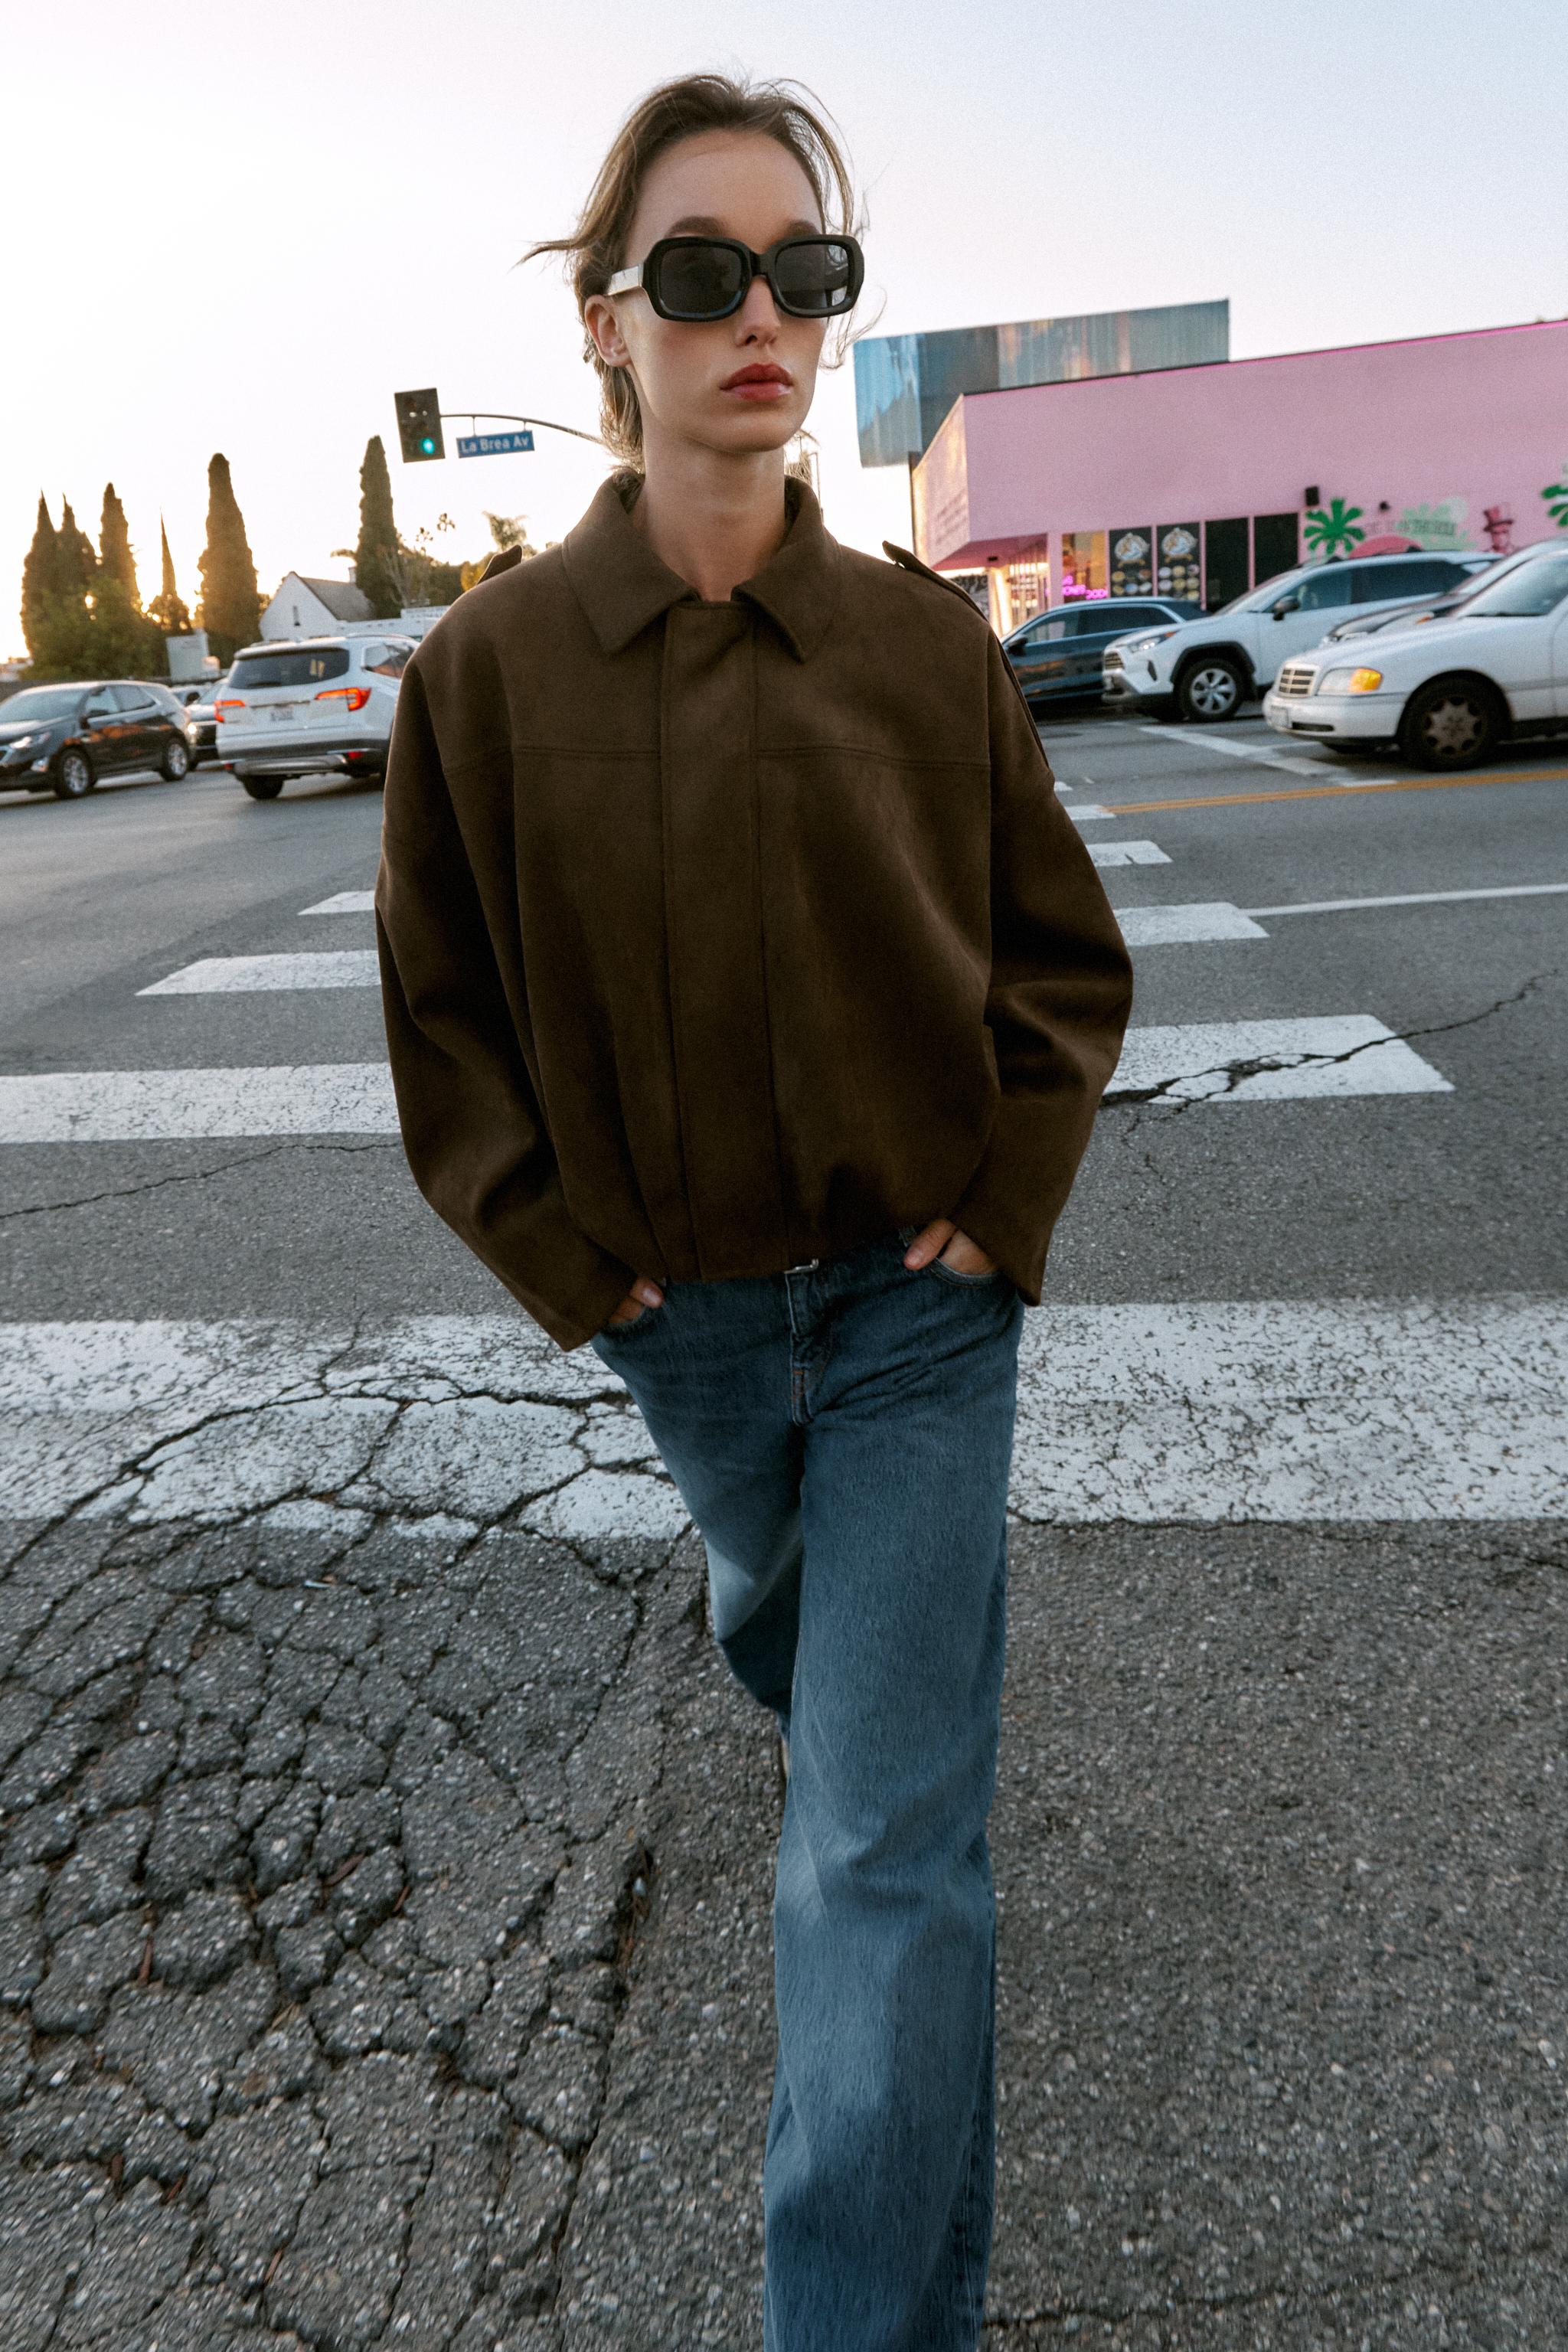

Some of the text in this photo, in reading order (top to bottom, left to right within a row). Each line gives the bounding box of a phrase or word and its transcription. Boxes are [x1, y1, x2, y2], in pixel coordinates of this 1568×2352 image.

[461, 435, 529, 453] La Brea Av
